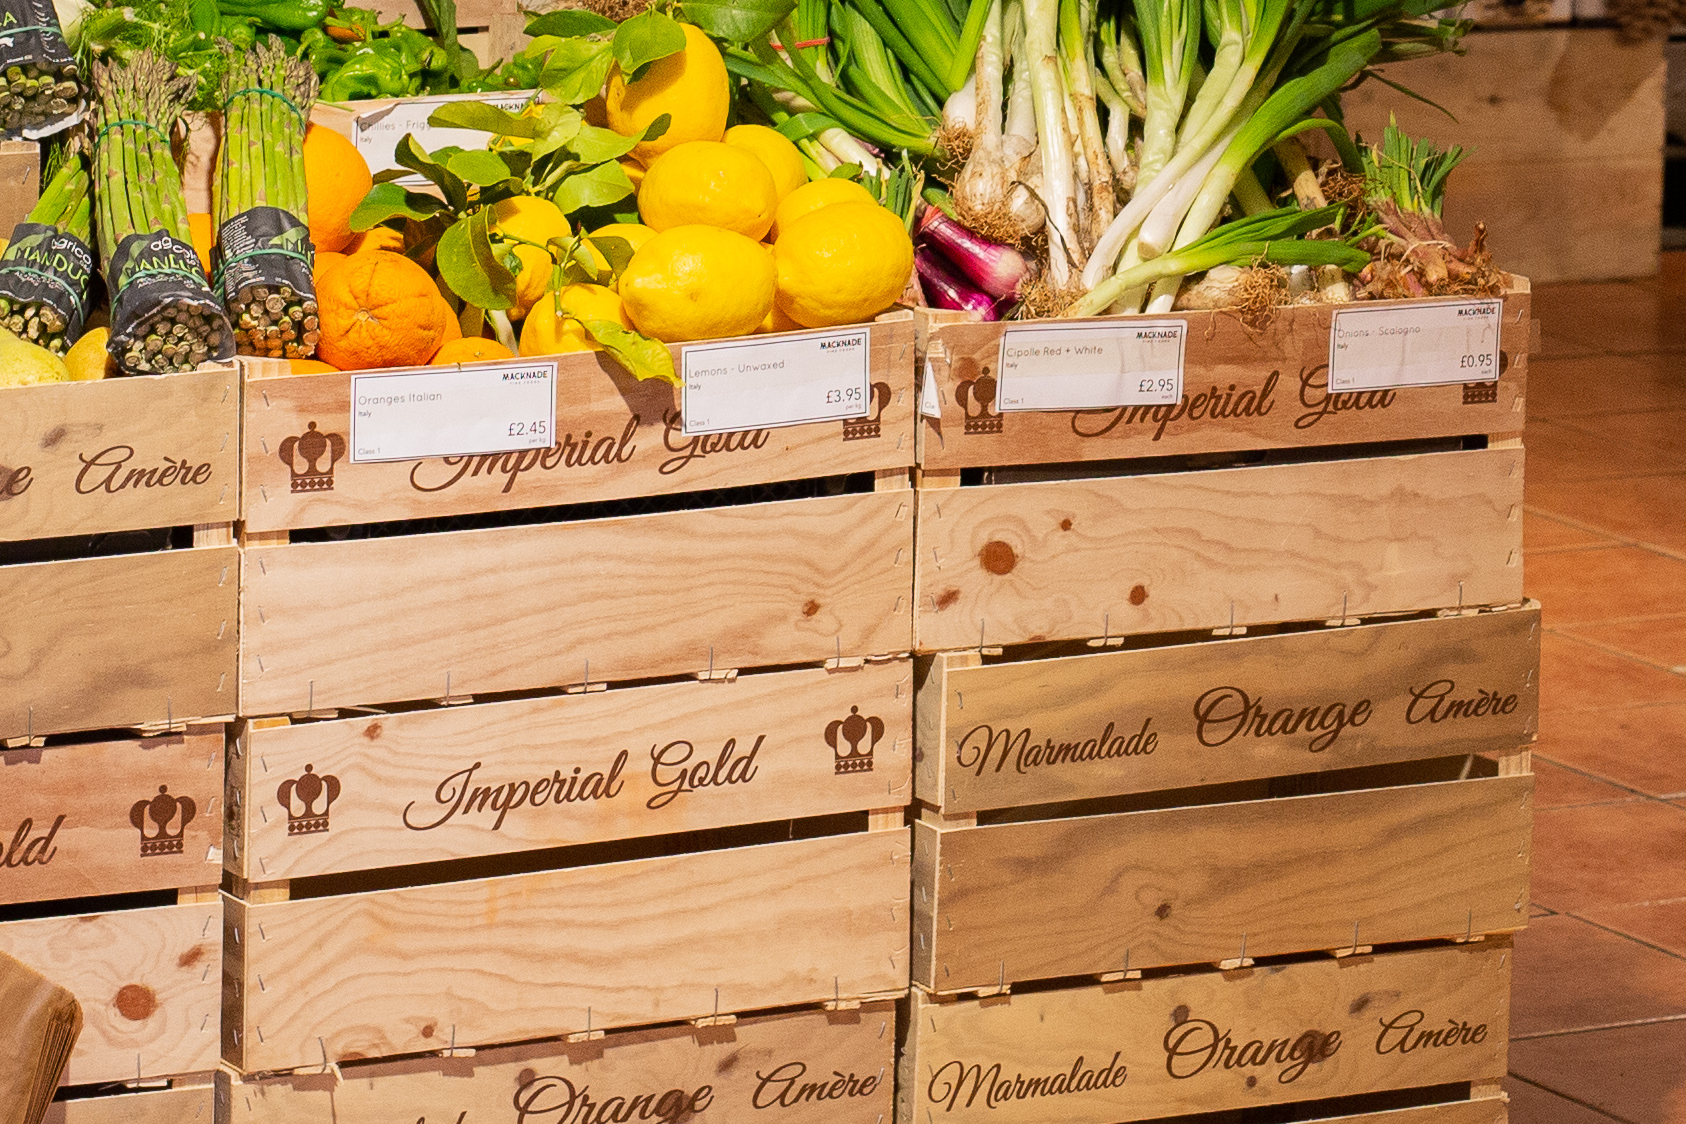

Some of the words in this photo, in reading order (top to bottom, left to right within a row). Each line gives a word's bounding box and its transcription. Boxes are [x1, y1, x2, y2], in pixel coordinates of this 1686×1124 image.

[1457, 307, 1496, 317] MACKNADE
[1136, 331, 1177, 339] MACKNADE
[1337, 329, 1369, 339] Onions
[1378, 326, 1421, 337] Scalogno
[820, 338, 862, 350] MACKNADE
[1007, 347, 1041, 358] Cipolle
[1043, 347, 1062, 355] Red
[1074, 346, 1103, 355] White
[1460, 354, 1493, 368] £0.95
[689, 367, 728, 378] Lemons
[738, 360, 785, 373] Unwaxed
[502, 371, 548, 382] MACKNADE
[689, 383, 702, 391] Italy
[1138, 378, 1174, 393] £2.95
[358, 394, 405, 406] Oranges
[409, 392, 442, 403] Italian
[826, 387, 862, 404] £3.95
[358, 410, 371, 418] Italy
[508, 421, 546, 437] £2.45
[689, 419, 705, 427] Class
[74, 445, 213, 497] Amère
[956, 717, 1159, 776] Marmalade
[1193, 686, 1373, 754] Orange
[1405, 679, 1517, 725] Amère
[402, 749, 629, 832] Imperial
[645, 735, 767, 810] Gold
[927, 1051, 1128, 1112] Marmalade
[1163, 1018, 1342, 1084] Orange
[1376, 1009, 1488, 1056] Amère
[752, 1061, 878, 1110] Amère
